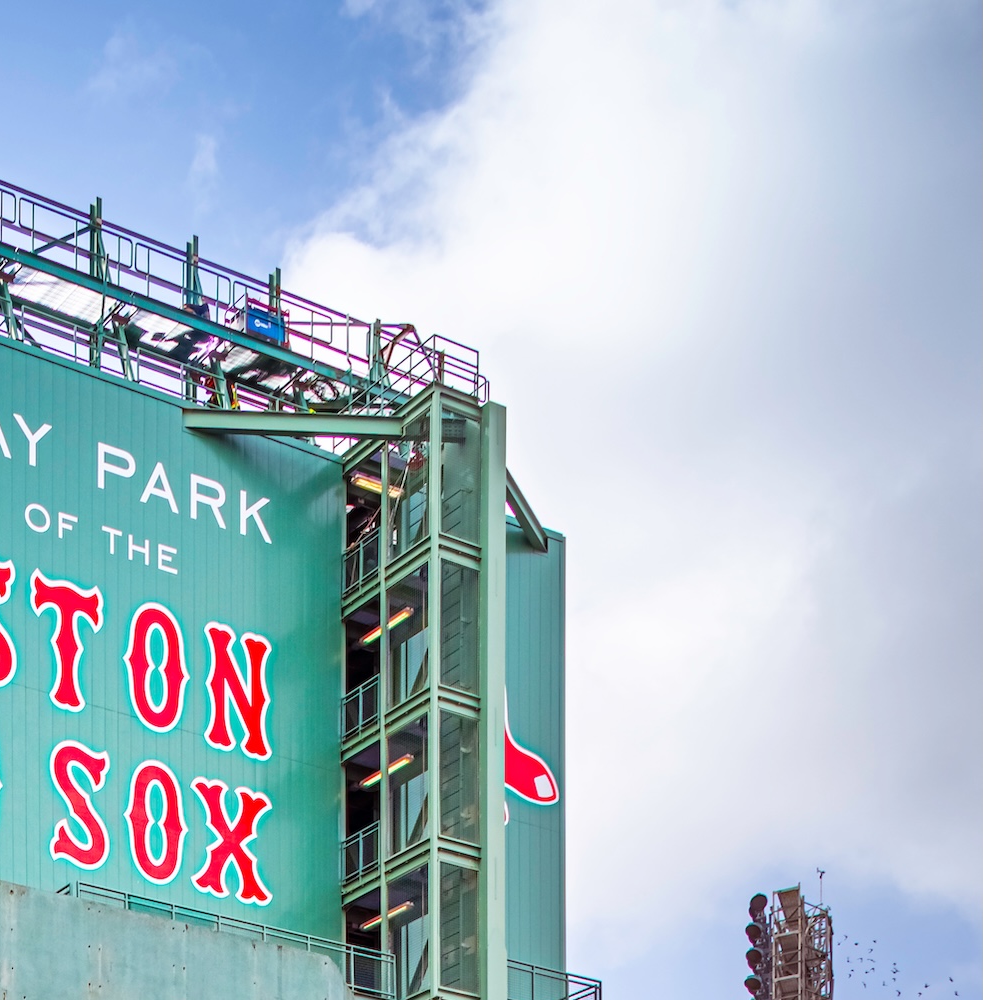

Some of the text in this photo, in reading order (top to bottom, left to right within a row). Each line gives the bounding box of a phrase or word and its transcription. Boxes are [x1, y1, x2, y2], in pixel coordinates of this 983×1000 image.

[24, 503, 79, 539] OF
[102, 525, 179, 575] THE
[96, 442, 272, 544] PARK
[49, 739, 273, 906] SOX
